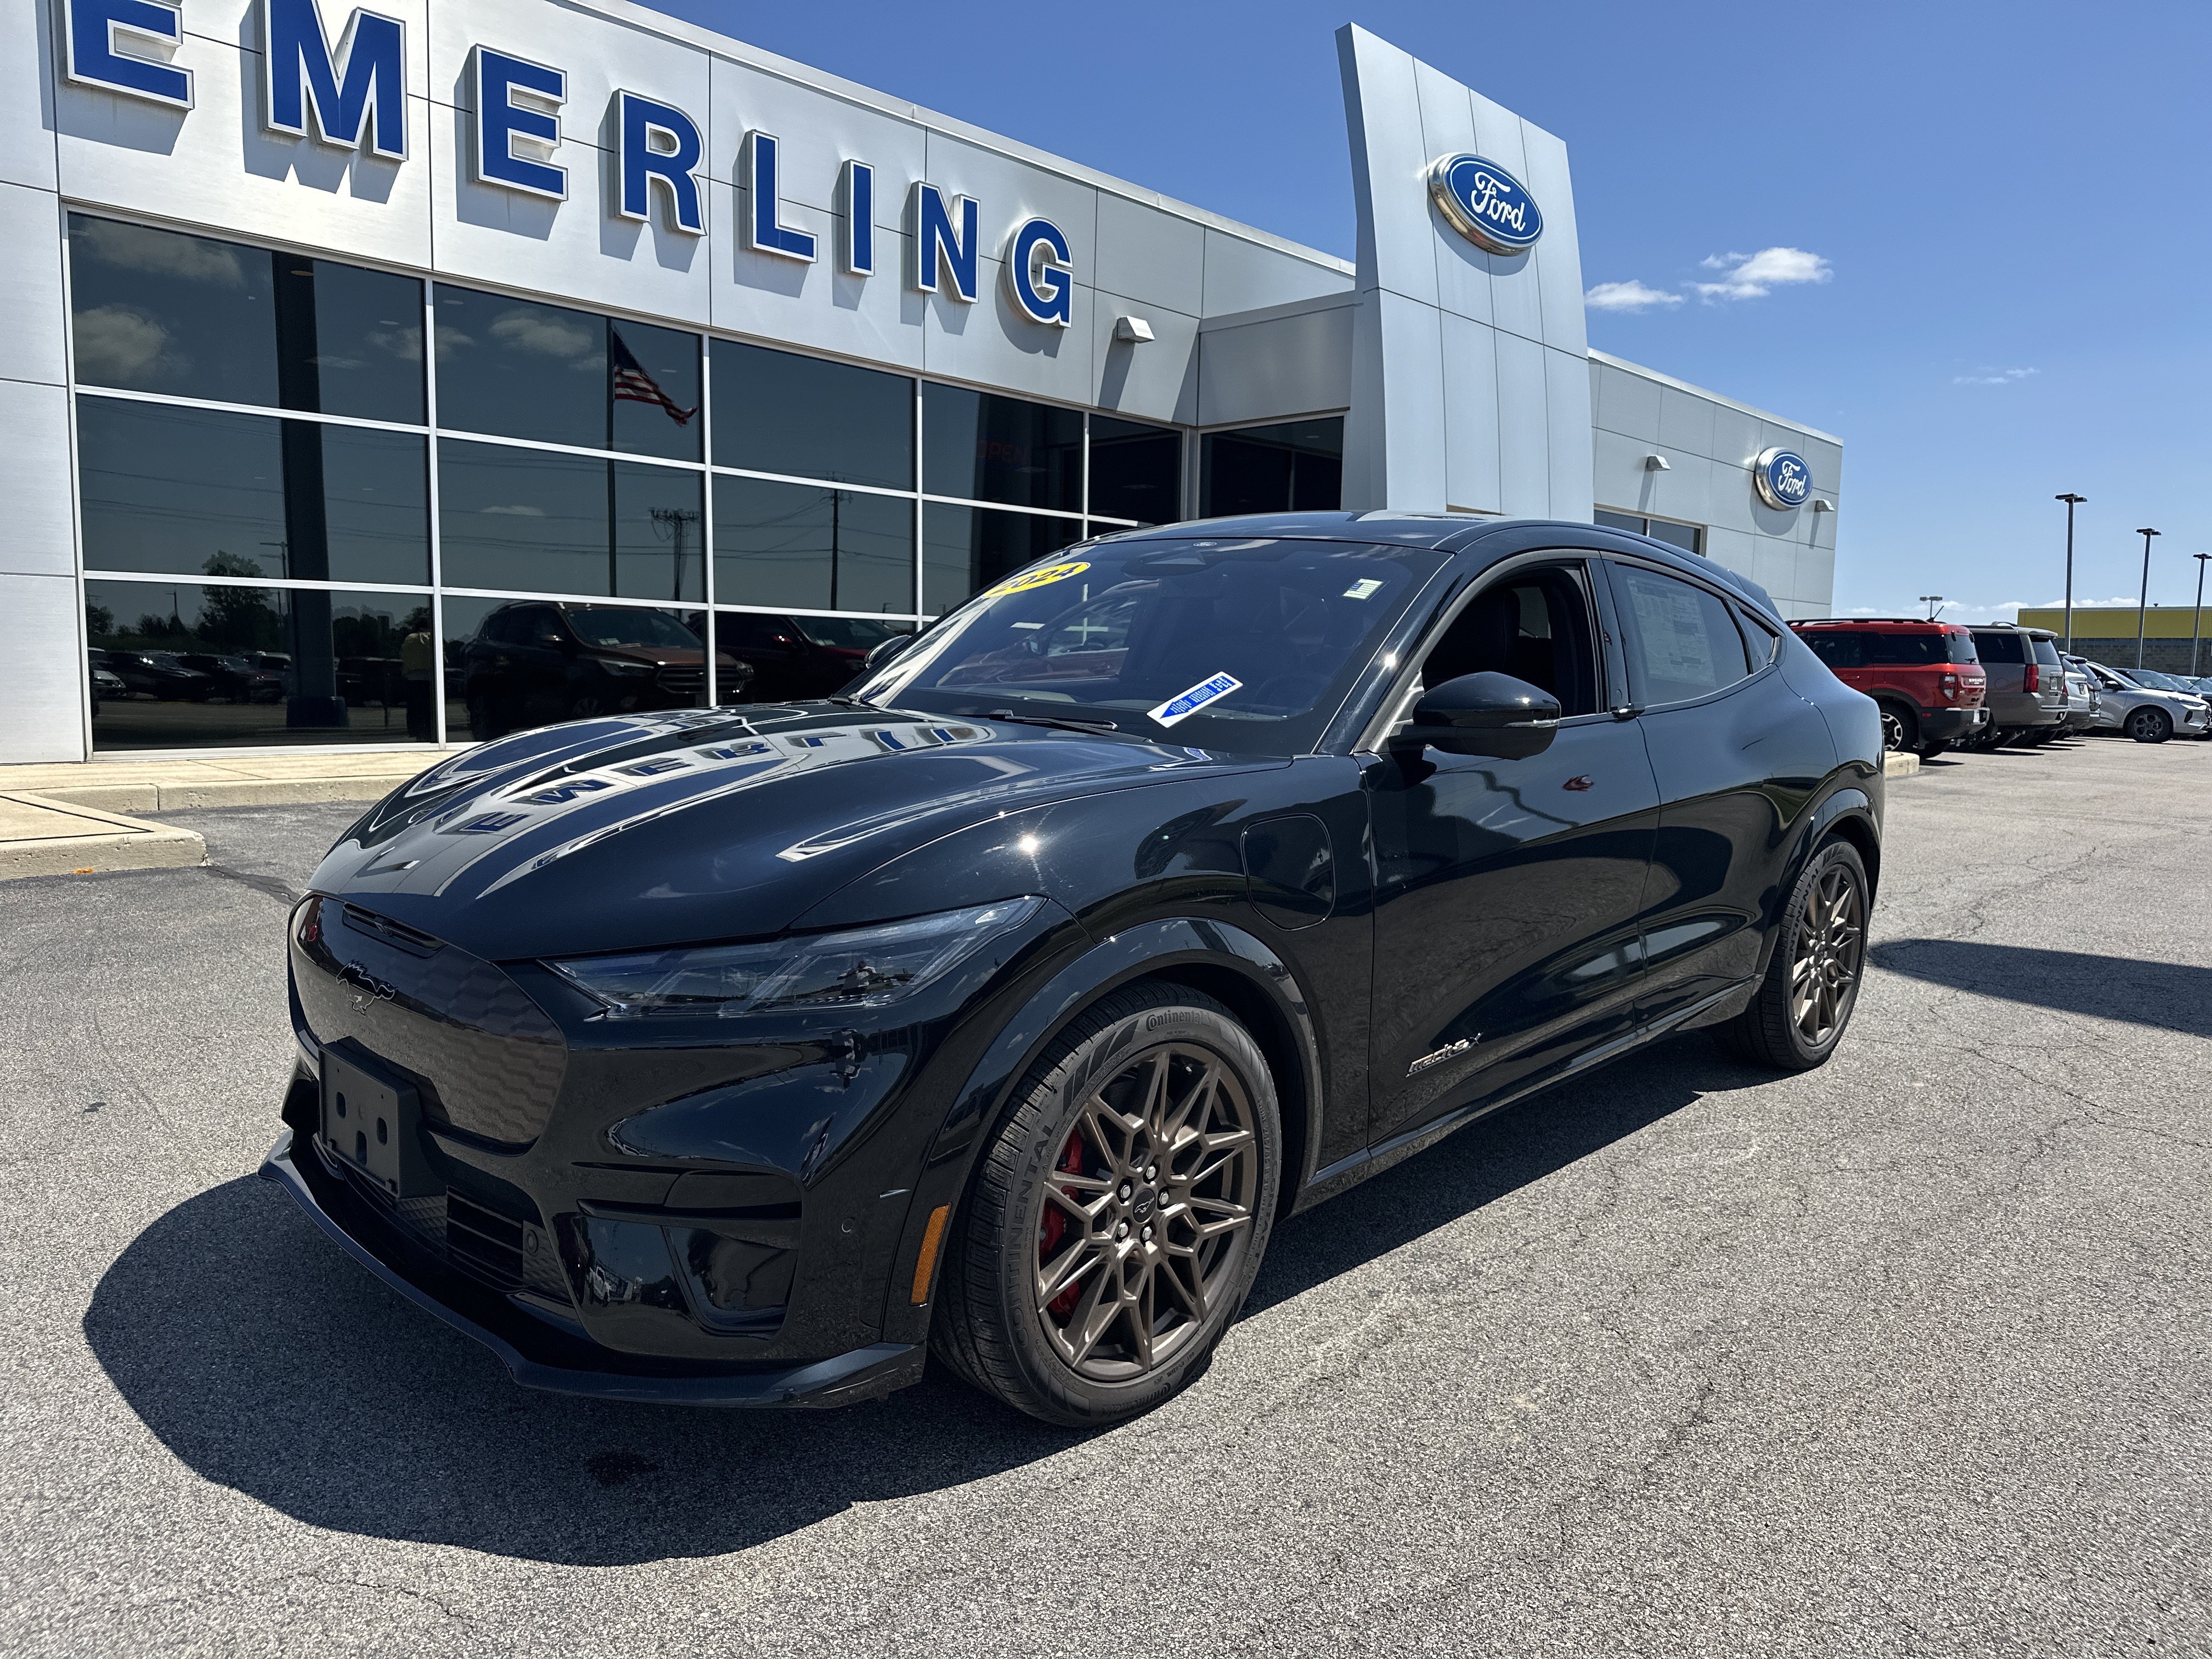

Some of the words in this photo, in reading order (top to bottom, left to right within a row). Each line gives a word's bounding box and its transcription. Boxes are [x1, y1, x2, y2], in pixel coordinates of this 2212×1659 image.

[65, 0, 1074, 329] EMERLING
[1471, 171, 1526, 232] Ford
[1778, 460, 1807, 496] Ford
[989, 564, 1082, 596] 2024
[1786, 868, 1819, 975] ONTINENTAL
[1146, 1009, 1203, 1032] Continental
[1008, 1121, 1058, 1348] CONTINENTAL
